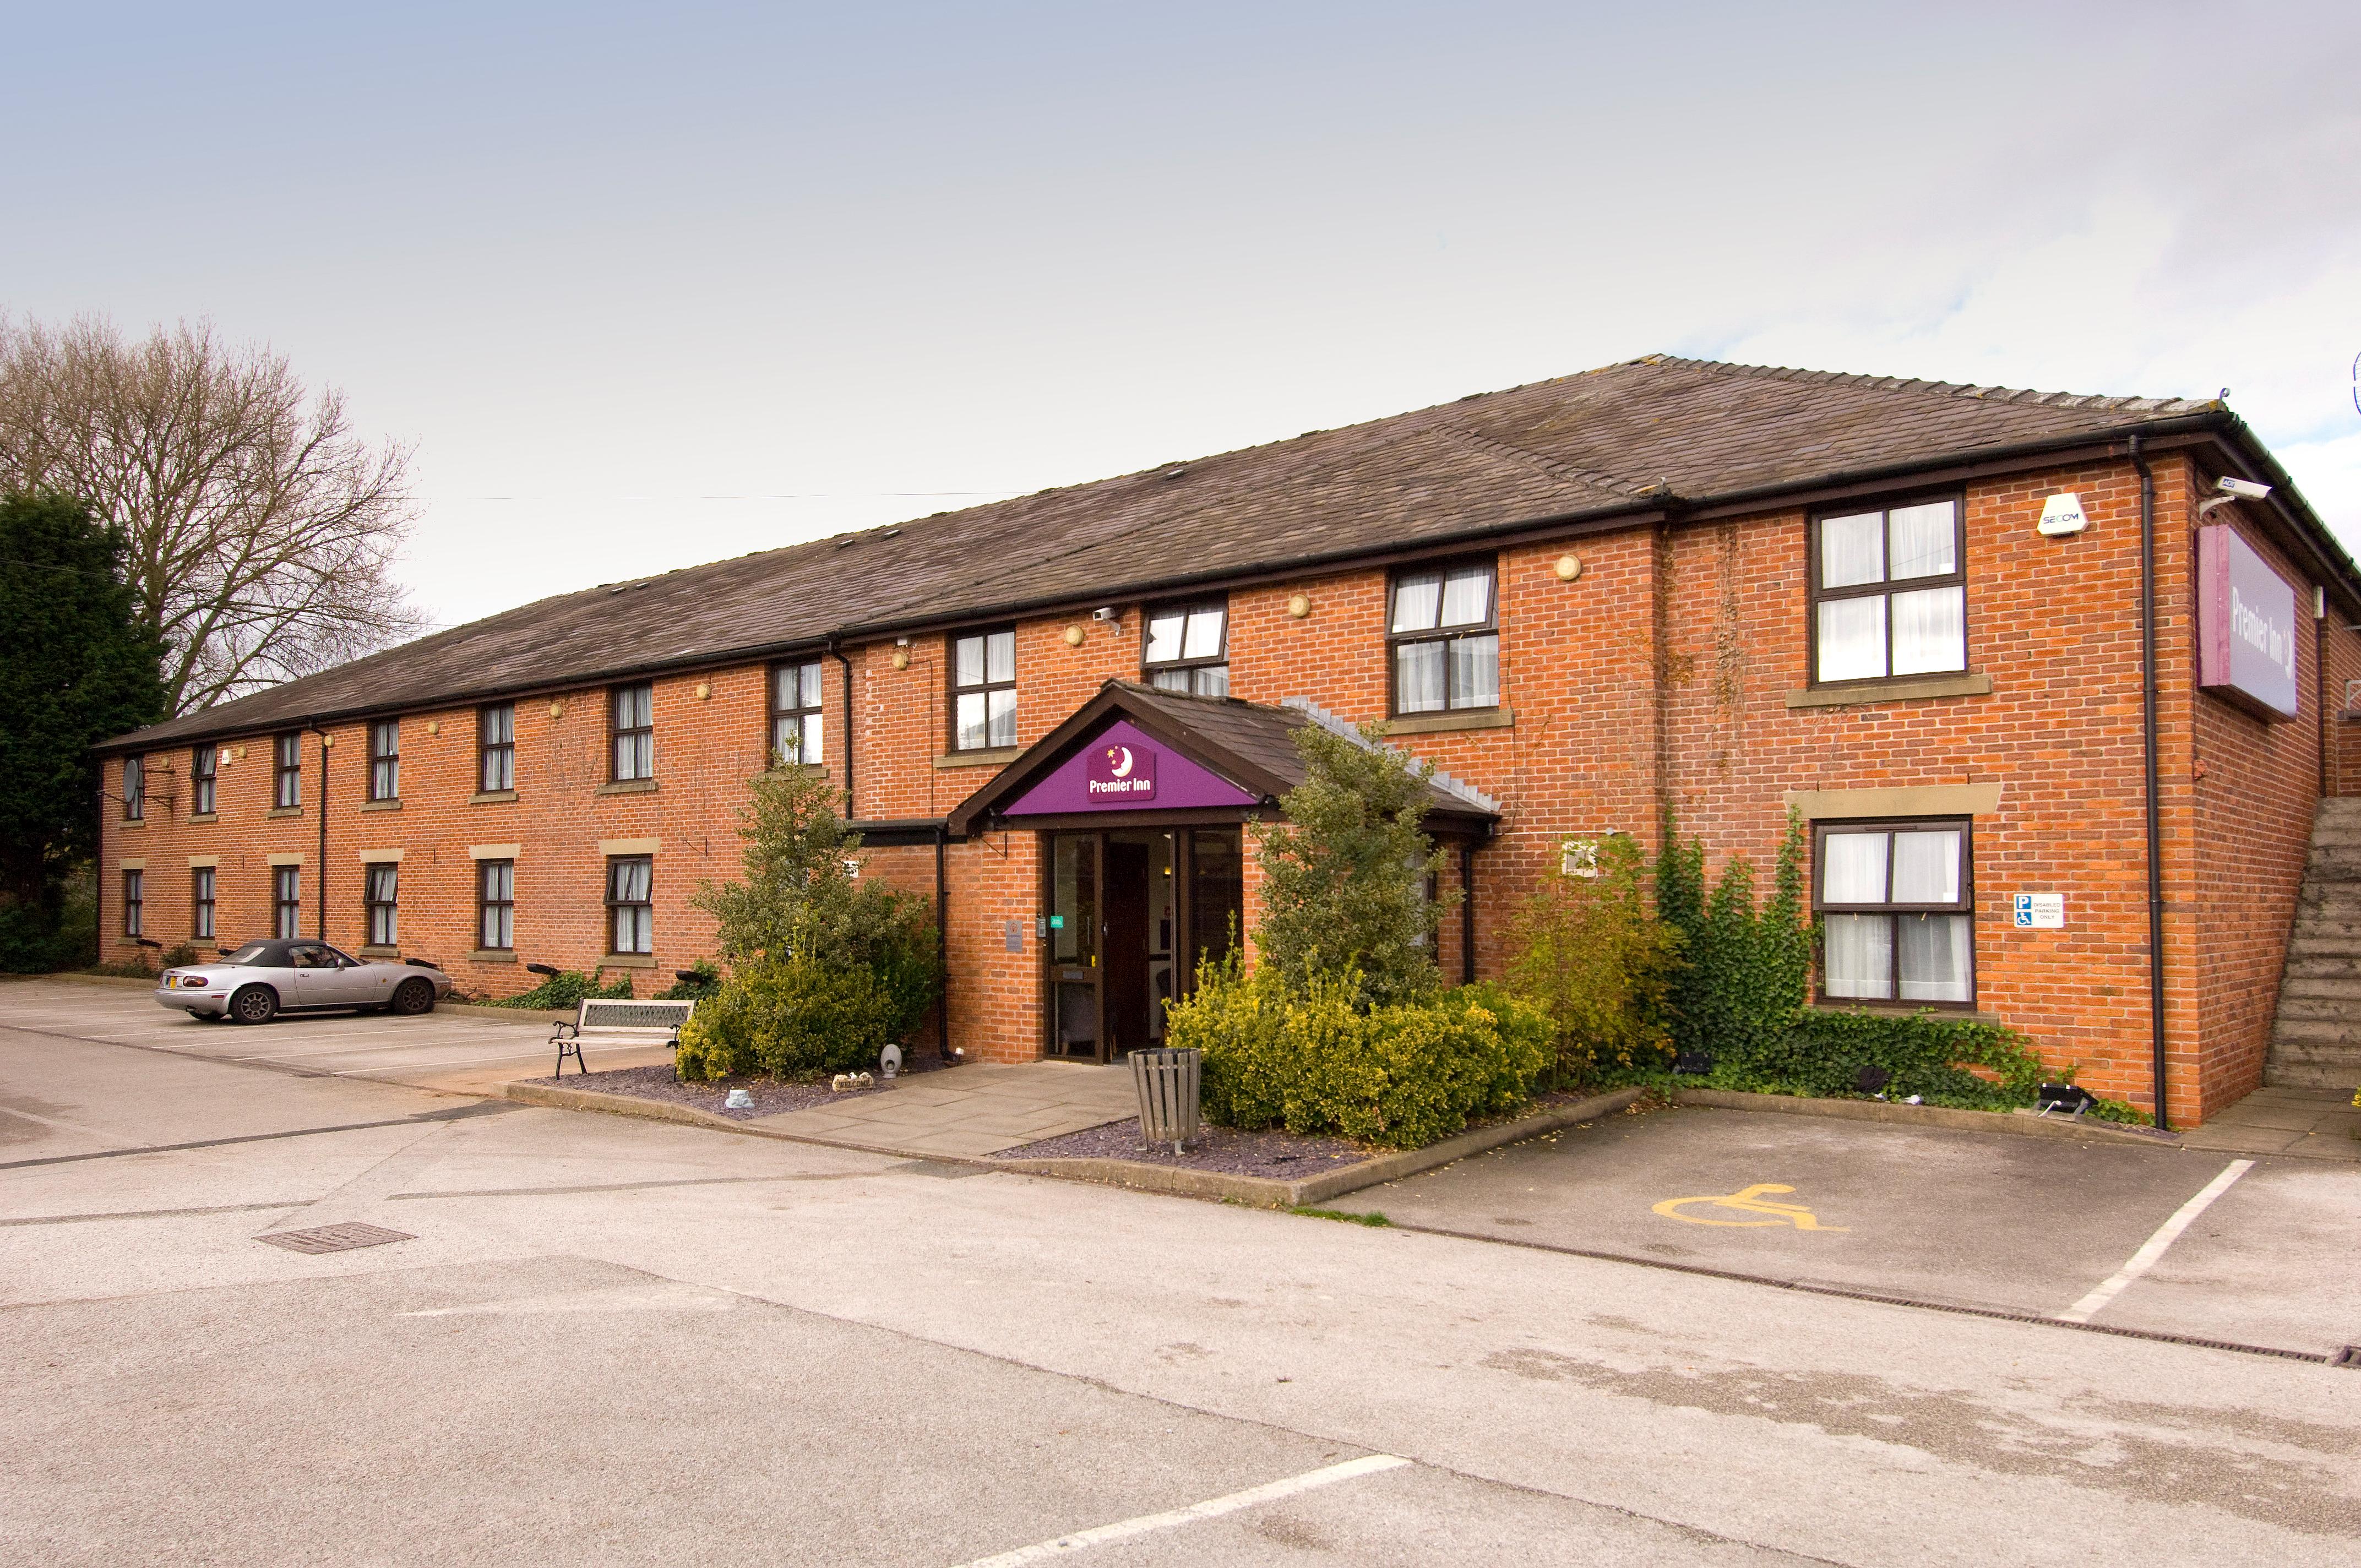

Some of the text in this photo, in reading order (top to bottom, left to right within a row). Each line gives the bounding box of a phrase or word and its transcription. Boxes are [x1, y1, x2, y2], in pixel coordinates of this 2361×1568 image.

[2043, 513, 2079, 524] SECOM
[2232, 586, 2282, 665] Premier Inn
[1090, 778, 1150, 793] Premier Inn
[2018, 896, 2029, 908] P
[839, 1080, 870, 1088] WELCOME
